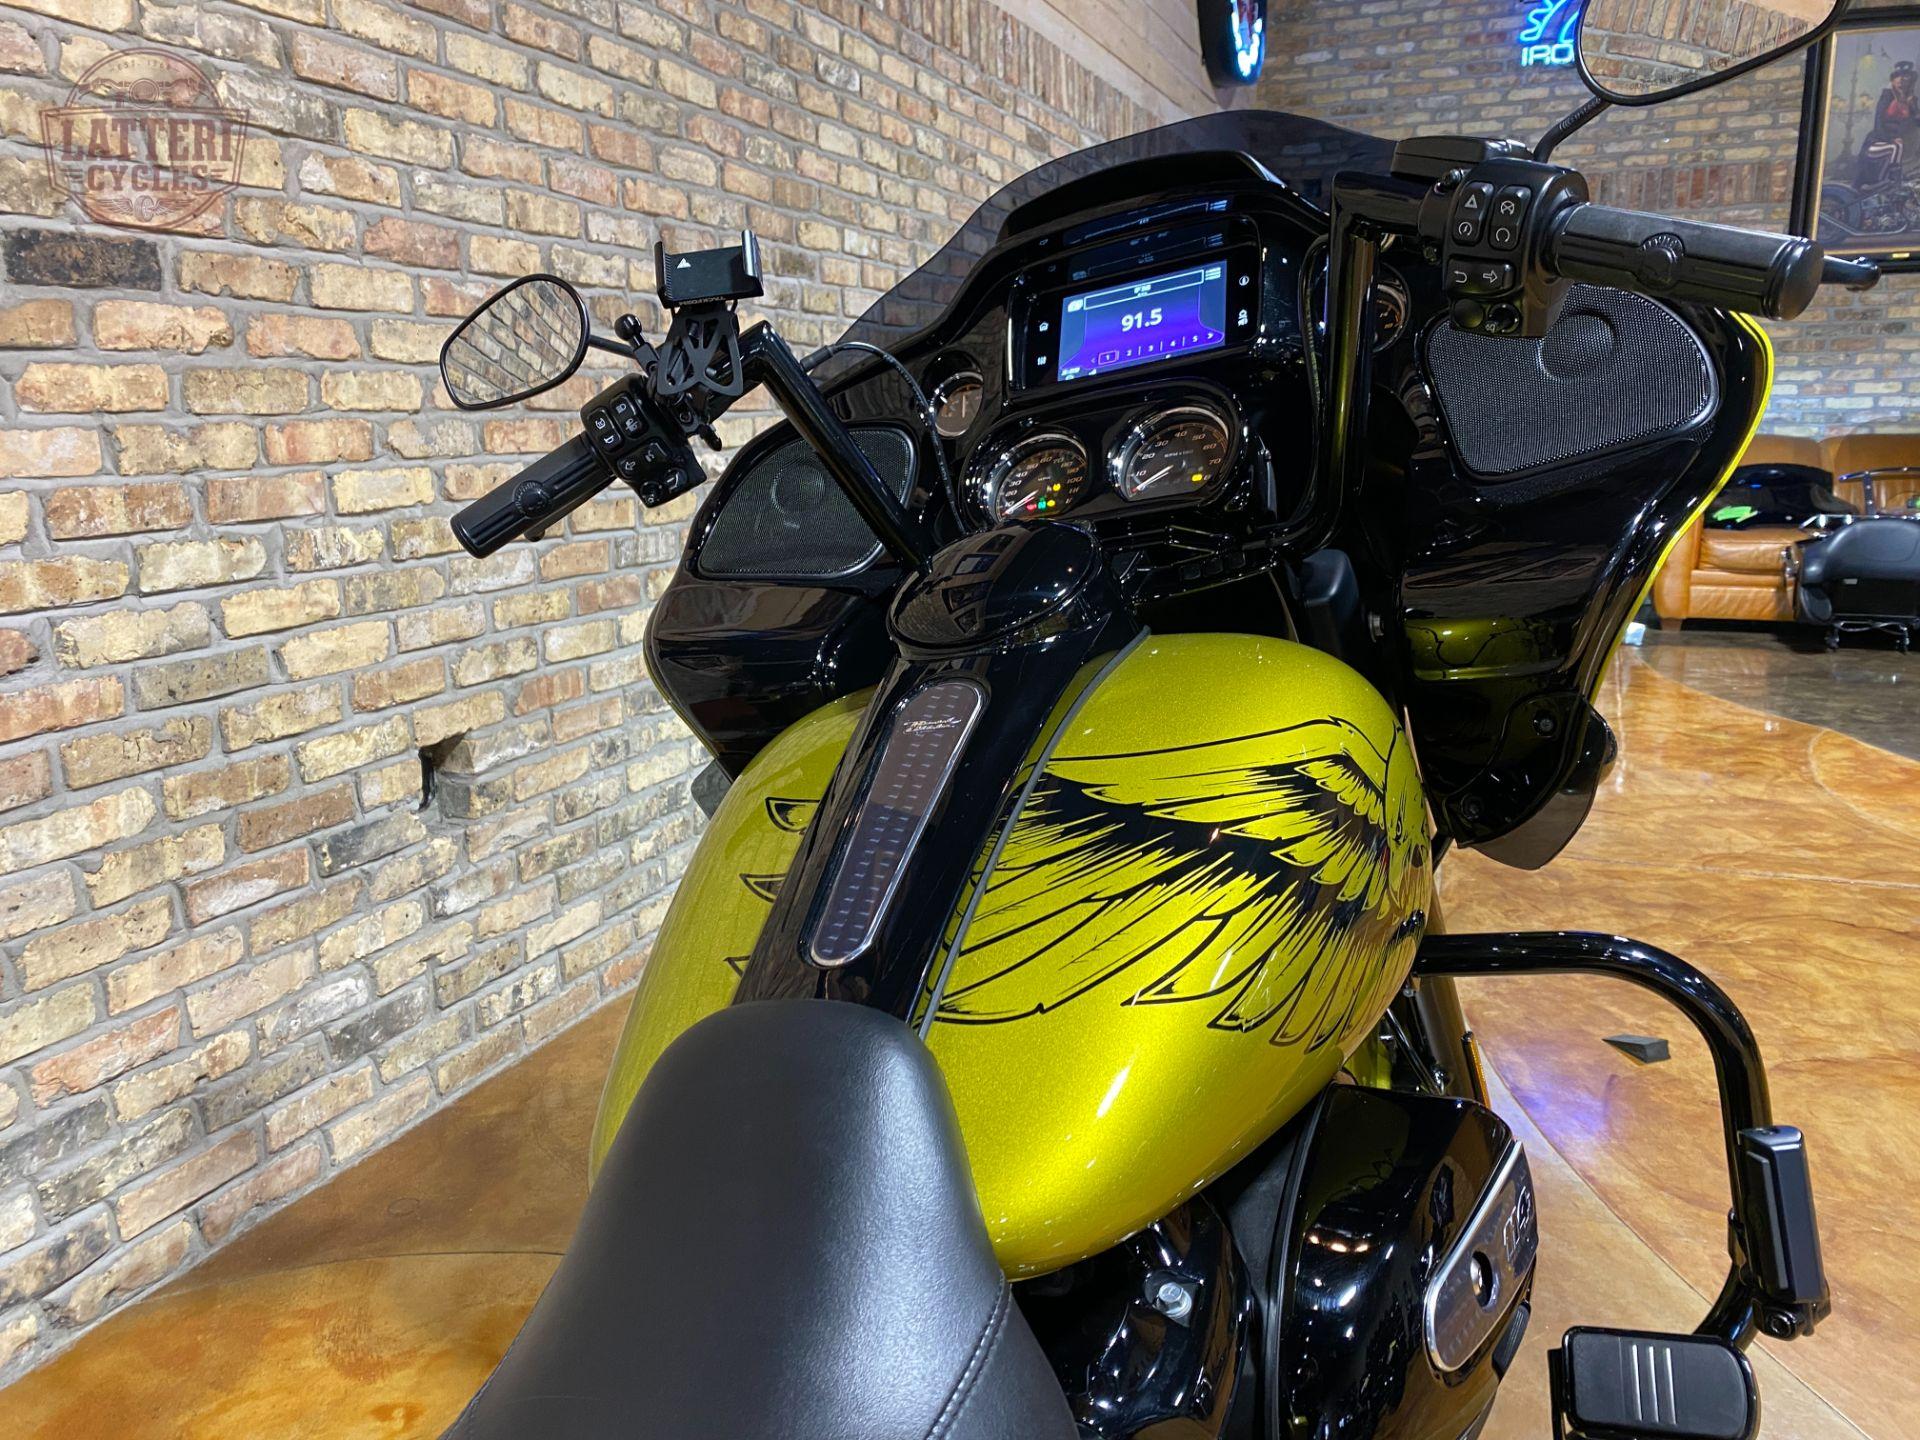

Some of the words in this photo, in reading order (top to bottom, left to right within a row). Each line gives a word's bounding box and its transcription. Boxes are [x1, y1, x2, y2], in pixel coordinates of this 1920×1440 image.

[1521, 43, 1575, 67] IRO
[1121, 308, 1163, 332] 91.5
[1192, 335, 1199, 343] 5
[1174, 430, 1188, 438] 40
[1155, 440, 1169, 448] 30
[1142, 452, 1156, 460] 20
[1005, 489, 1018, 497] 20
